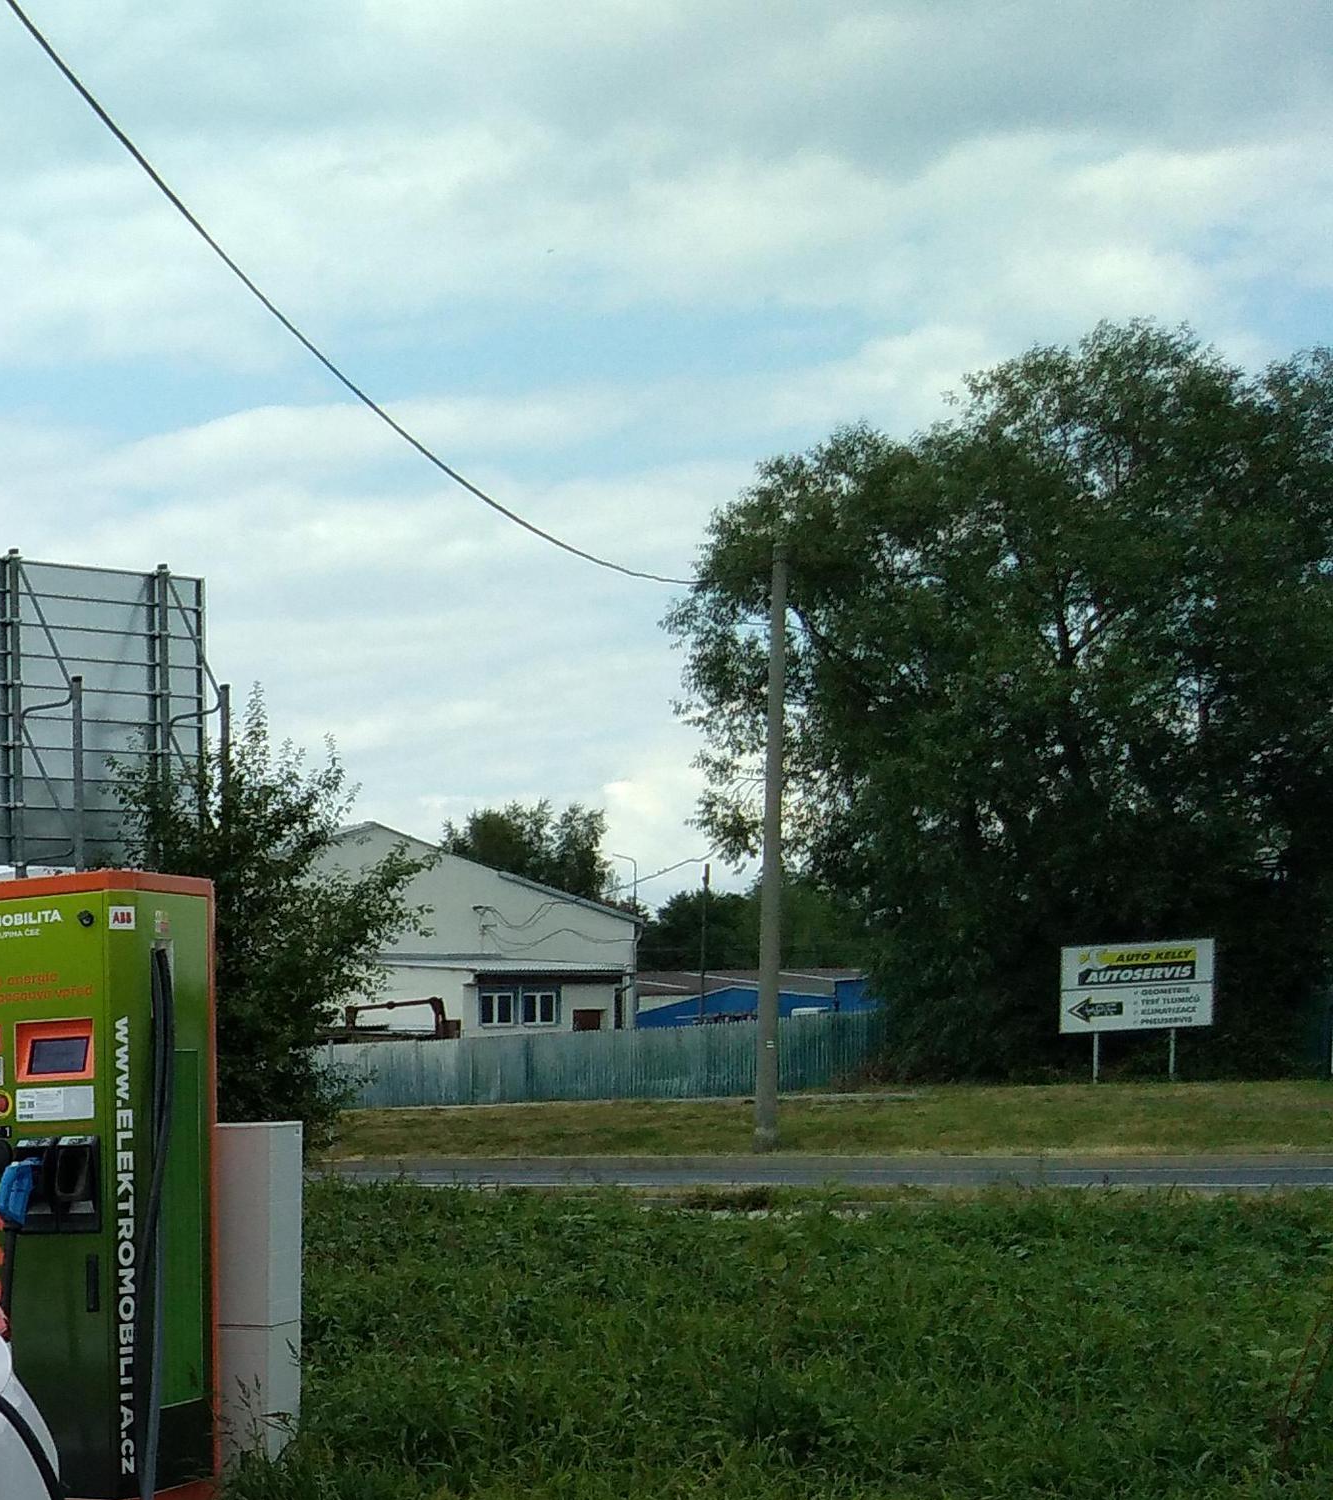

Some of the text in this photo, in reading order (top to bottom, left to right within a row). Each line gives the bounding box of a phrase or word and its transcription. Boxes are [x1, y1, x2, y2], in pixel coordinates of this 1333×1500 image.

[112, 911, 132, 925] ABB
[1116, 949, 1193, 963] AUTO KELLY
[1085, 965, 1193, 983] AUTOSERVIS
[1140, 1016, 1193, 1025] PNEUSERVIS
